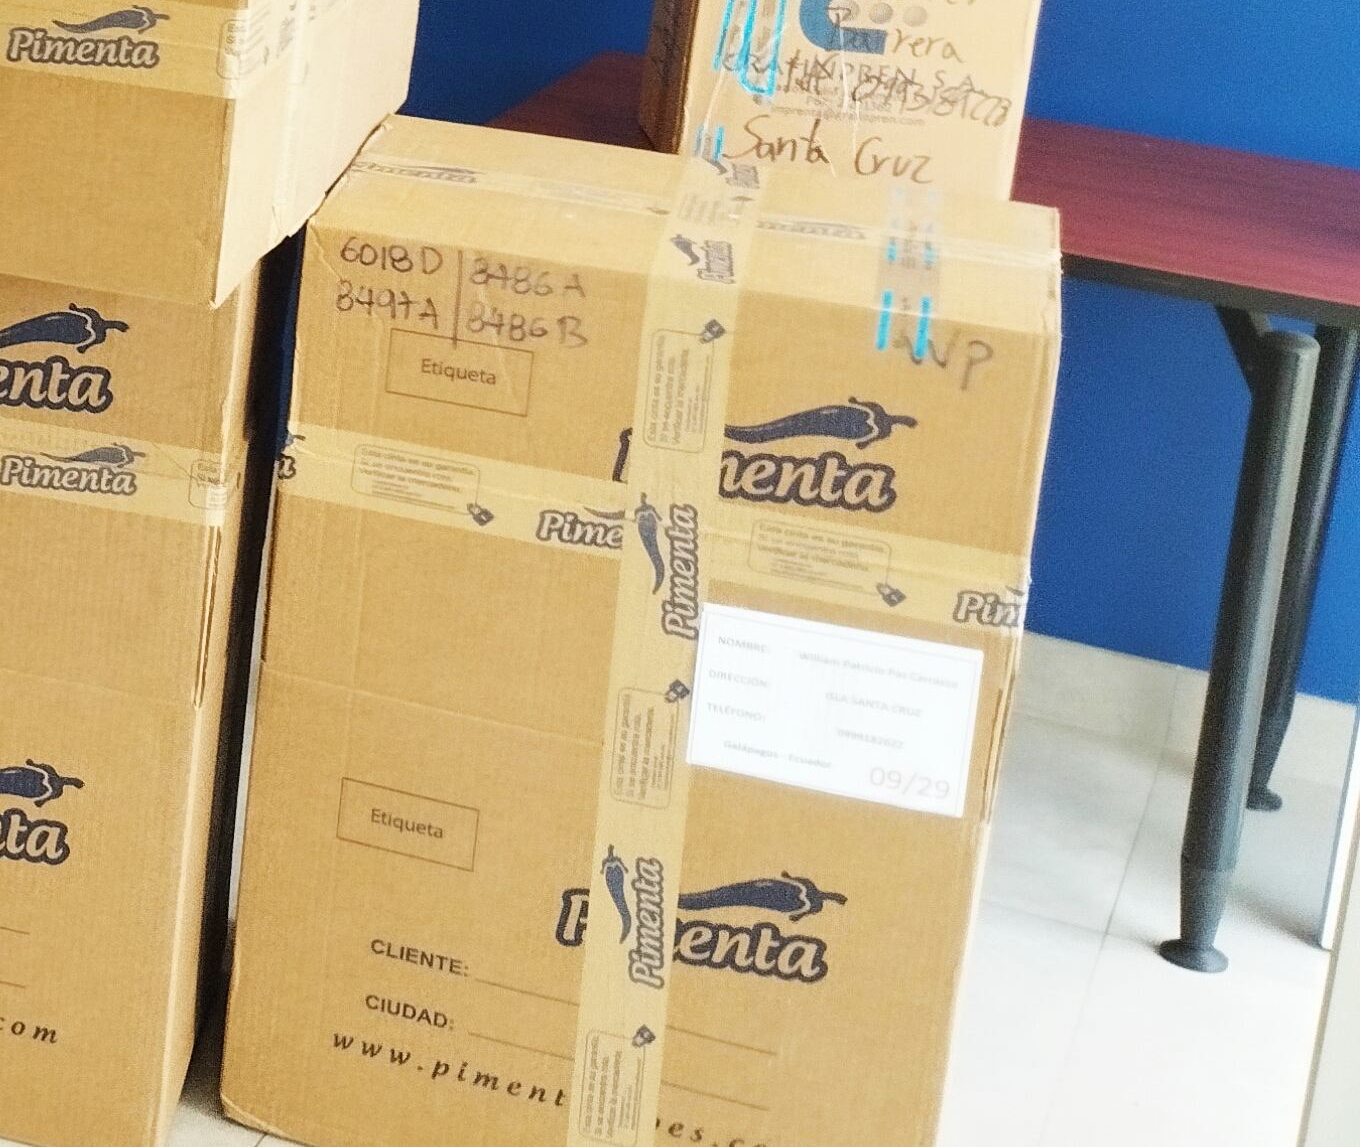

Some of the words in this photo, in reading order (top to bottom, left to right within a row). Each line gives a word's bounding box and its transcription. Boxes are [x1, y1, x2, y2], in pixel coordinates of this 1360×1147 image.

[6, 26, 160, 69] Pimenta
[723, 115, 830, 165] Santa
[854, 136, 934, 184] Cruz
[420, 358, 496, 385] Etiqueta
[0, 454, 137, 496] Pimenta
[537, 510, 624, 550] Pime
[661, 504, 699, 640] Pimenta
[869, 766, 951, 800] 09/29
[370, 807, 444, 840] Etiqueta
[627, 856, 664, 990] Pimenta
[370, 937, 470, 978] CLIENTE:
[364, 994, 455, 1031] CIUDAD:
